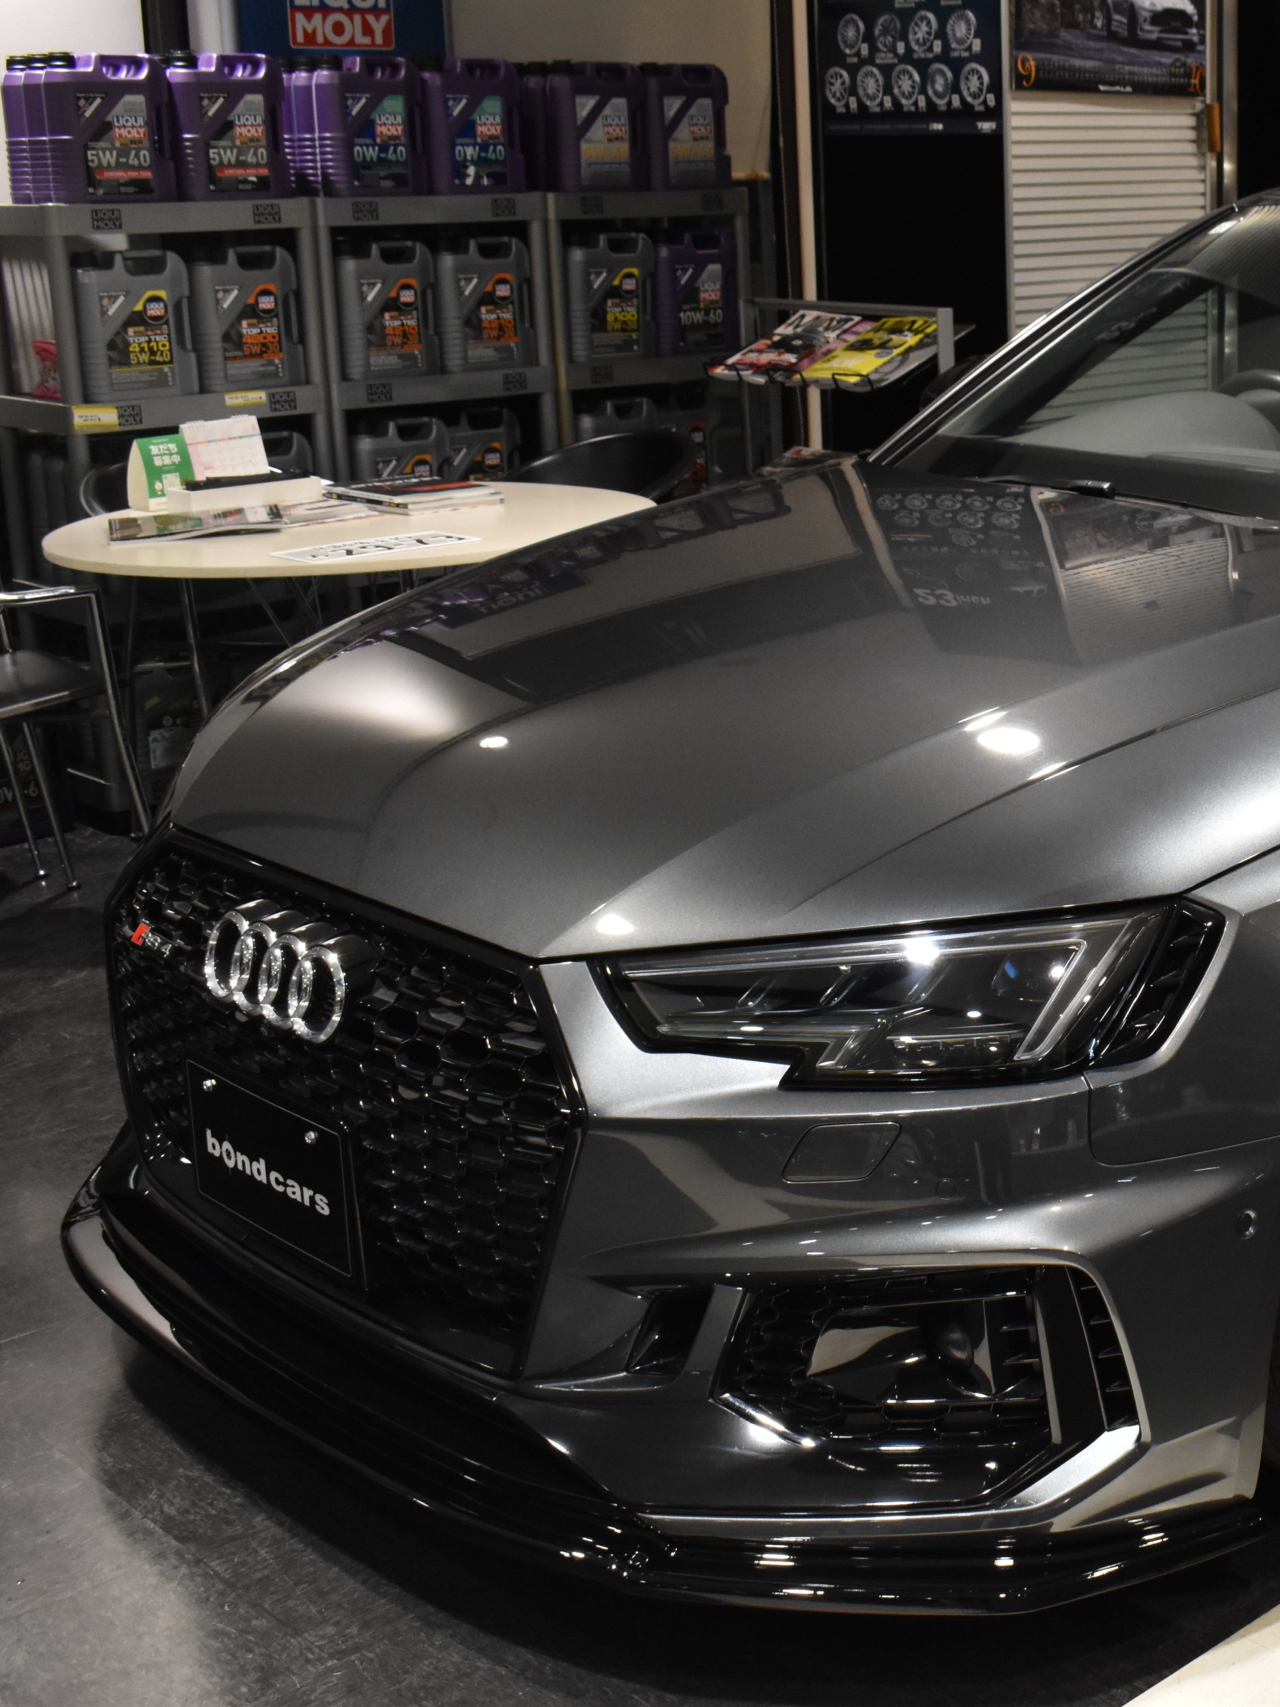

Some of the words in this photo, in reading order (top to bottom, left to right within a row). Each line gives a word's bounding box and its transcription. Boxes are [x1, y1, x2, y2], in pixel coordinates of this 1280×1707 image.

[294, 12, 390, 45] MOLY
[1016, 52, 1037, 87] 9
[113, 116, 144, 126] LIQUI
[234, 115, 263, 126] LIQUI
[376, 115, 402, 124] LIQUI
[476, 115, 501, 124] LIQUI
[114, 127, 146, 138] MOLY
[236, 126, 264, 137] MOLY
[377, 124, 404, 135] MOLY
[477, 125, 502, 135] MOLY
[87, 150, 150, 167] 5W-40
[209, 148, 268, 166] 5W-40
[354, 146, 407, 162] 0W-40
[455, 146, 505, 161] 0W-40
[254, 205, 280, 214] LIQUI
[353, 202, 378, 210] LIQUI
[92, 210, 120, 220] LIQUI
[256, 214, 280, 224] MOLY
[354, 210, 379, 220] MOLY
[93, 220, 122, 230] MOLY
[146, 302, 164, 310] LIQUI
[258, 302, 276, 310] MOLY
[679, 310, 723, 326] 10W-60
[262, 326, 278, 334] TEC
[150, 334, 169, 342] TEC
[242, 334, 280, 343] 4200
[128, 341, 170, 352] 4110
[243, 343, 280, 355] 5W-30
[130, 352, 170, 364] 5W-40
[366, 384, 391, 392] LIQUI
[270, 393, 295, 402] LIQUI
[368, 393, 392, 402] MOLY
[119, 406, 140, 414] IQUI
[271, 402, 296, 410] MOLY
[149, 444, 178, 455] 友だち
[153, 454, 182, 467] 募集中
